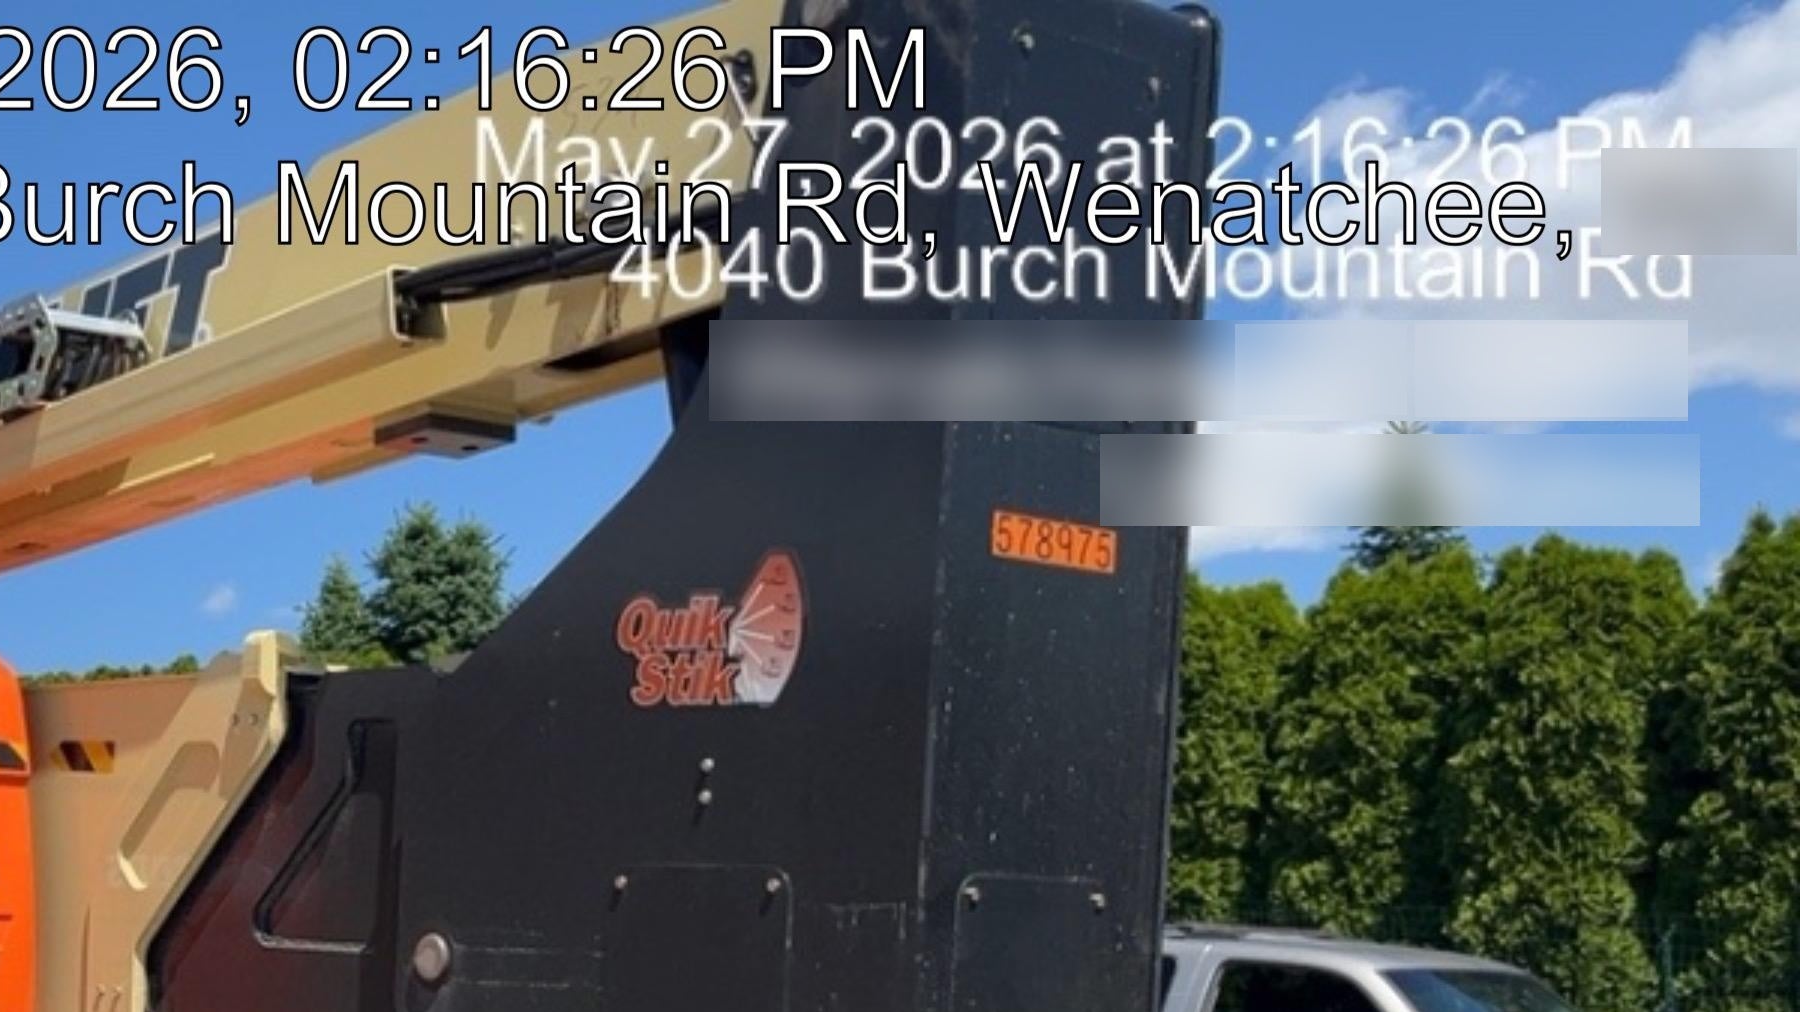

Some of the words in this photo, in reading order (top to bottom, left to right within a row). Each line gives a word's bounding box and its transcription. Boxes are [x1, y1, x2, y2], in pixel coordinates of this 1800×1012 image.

[995, 519, 1115, 568] 578975
[617, 594, 735, 655] Quik
[630, 651, 743, 707] Stik
